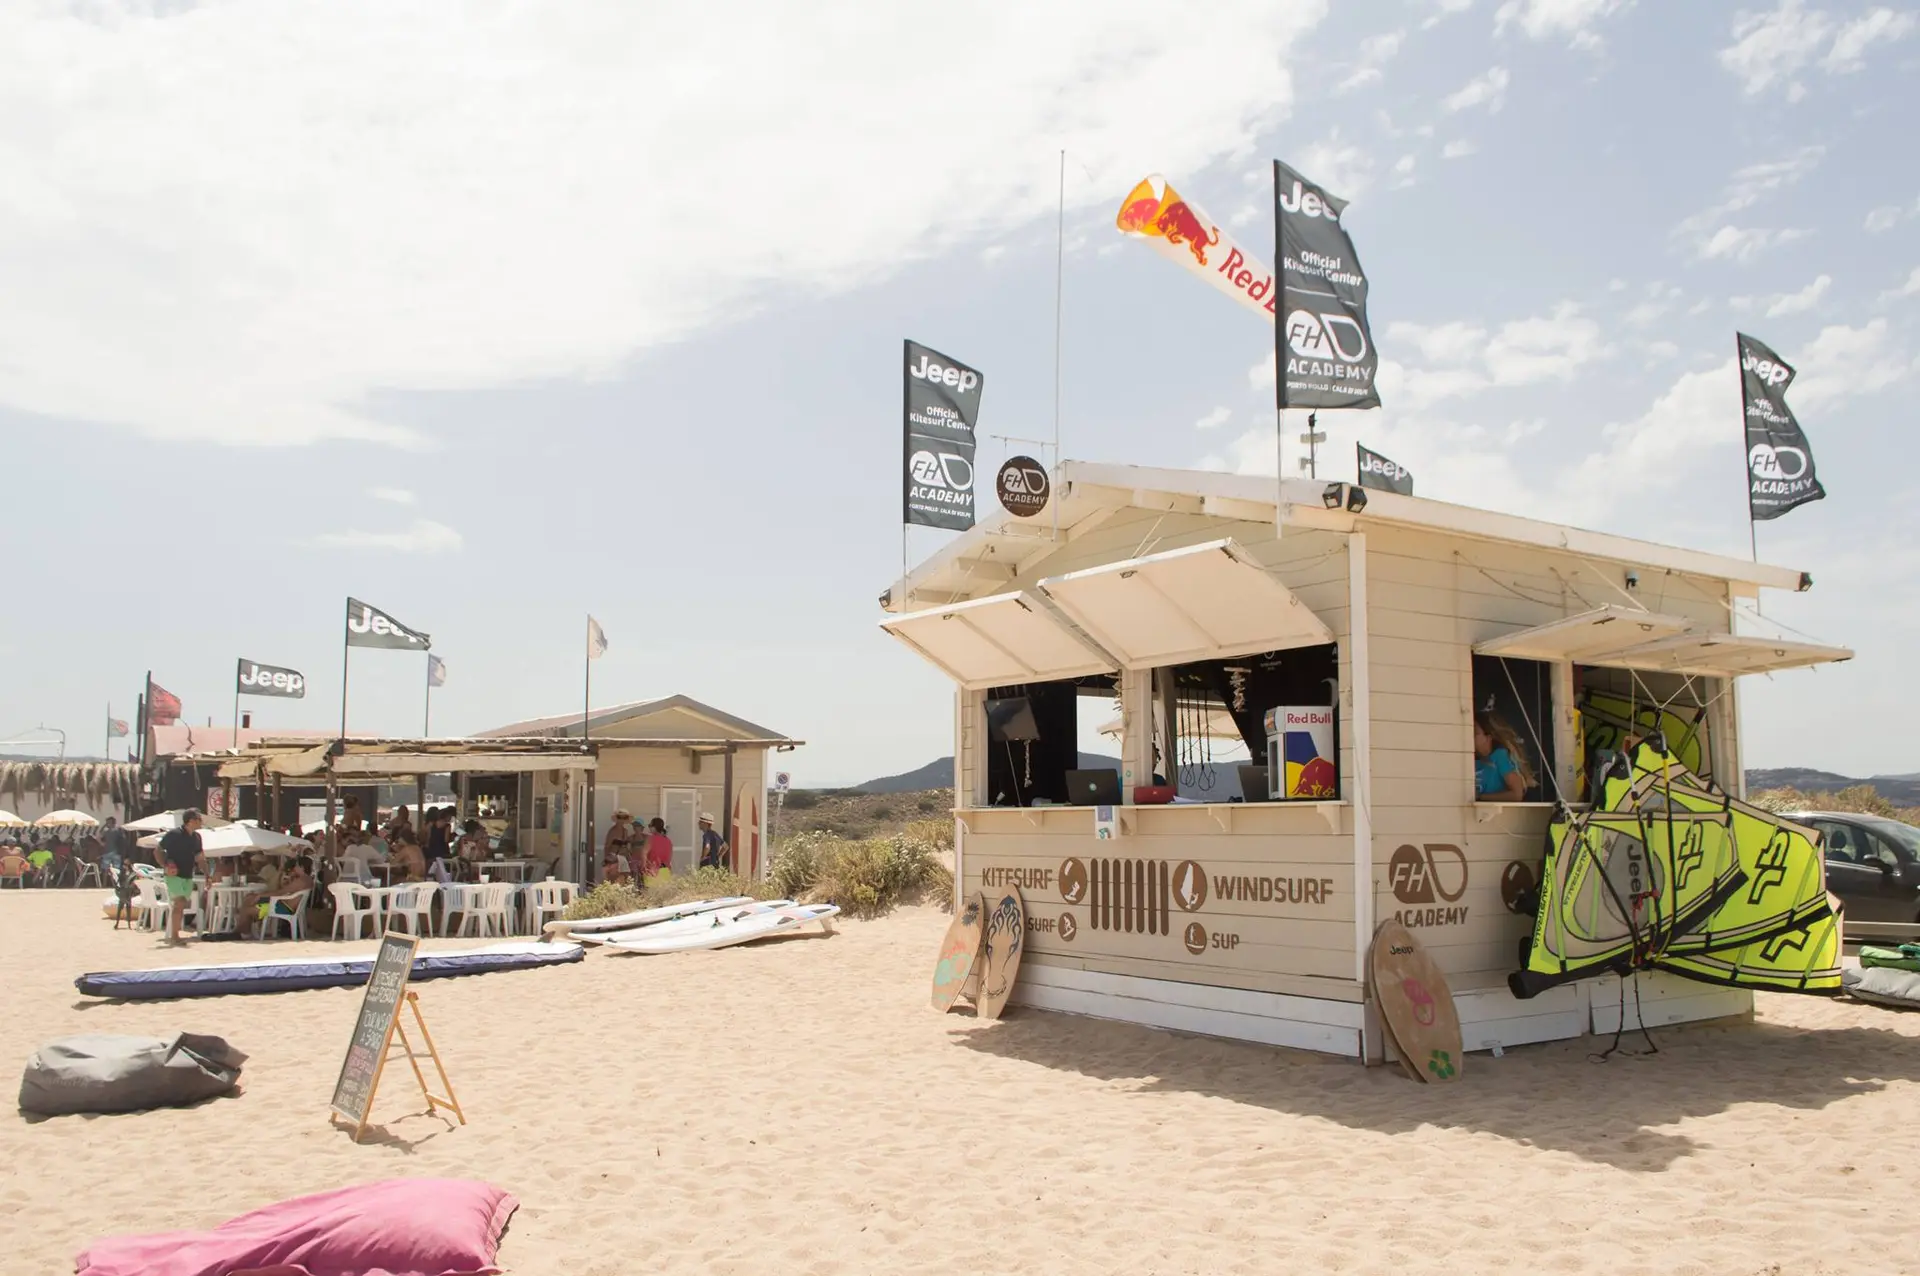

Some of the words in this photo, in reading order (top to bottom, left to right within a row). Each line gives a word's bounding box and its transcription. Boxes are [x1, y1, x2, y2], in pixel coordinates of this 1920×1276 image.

[1301, 250, 1341, 270] Official
[1218, 246, 1271, 301] Red
[1325, 269, 1362, 287] Center
[910, 356, 978, 393] Jeep
[1287, 358, 1371, 381] ACADEMY
[926, 406, 959, 420] Official
[1360, 453, 1408, 481] Jeep
[909, 486, 973, 506] ACADEMY
[1002, 493, 1045, 505] ACADEMY
[240, 664, 303, 693] Jeep
[1287, 712, 1309, 724] Red
[1310, 712, 1332, 724] Bull
[982, 867, 1053, 890] KITESURF
[1213, 875, 1334, 904] WINDSURF
[1027, 917, 1056, 933] SURF
[1394, 906, 1470, 928] ACADEMY
[1211, 932, 1240, 950] SUP
